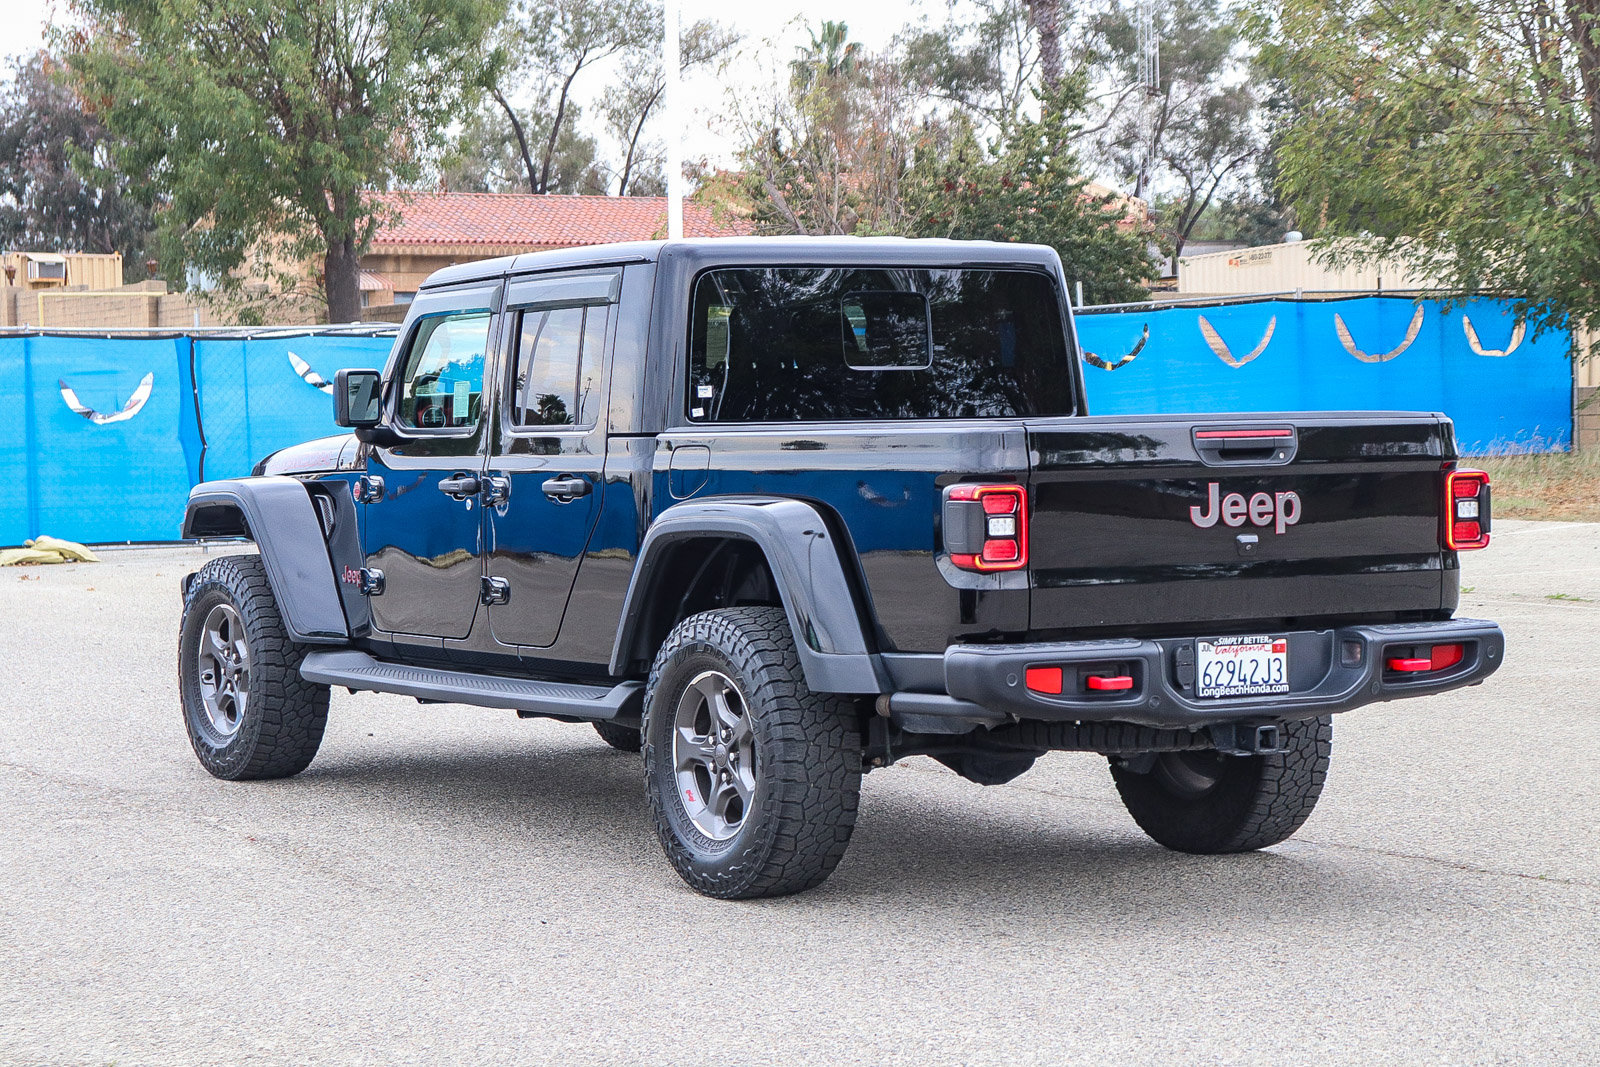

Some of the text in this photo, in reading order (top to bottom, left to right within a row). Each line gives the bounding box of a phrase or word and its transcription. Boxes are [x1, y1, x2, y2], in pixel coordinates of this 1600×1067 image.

[1190, 482, 1301, 535] Jeep
[342, 565, 361, 588] Jeep
[1218, 636, 1269, 646] SIMPLY BETTER
[1215, 645, 1271, 658] California
[1203, 658, 1282, 687] 62942J3
[1200, 684, 1290, 698] LongBeachHonda.com
